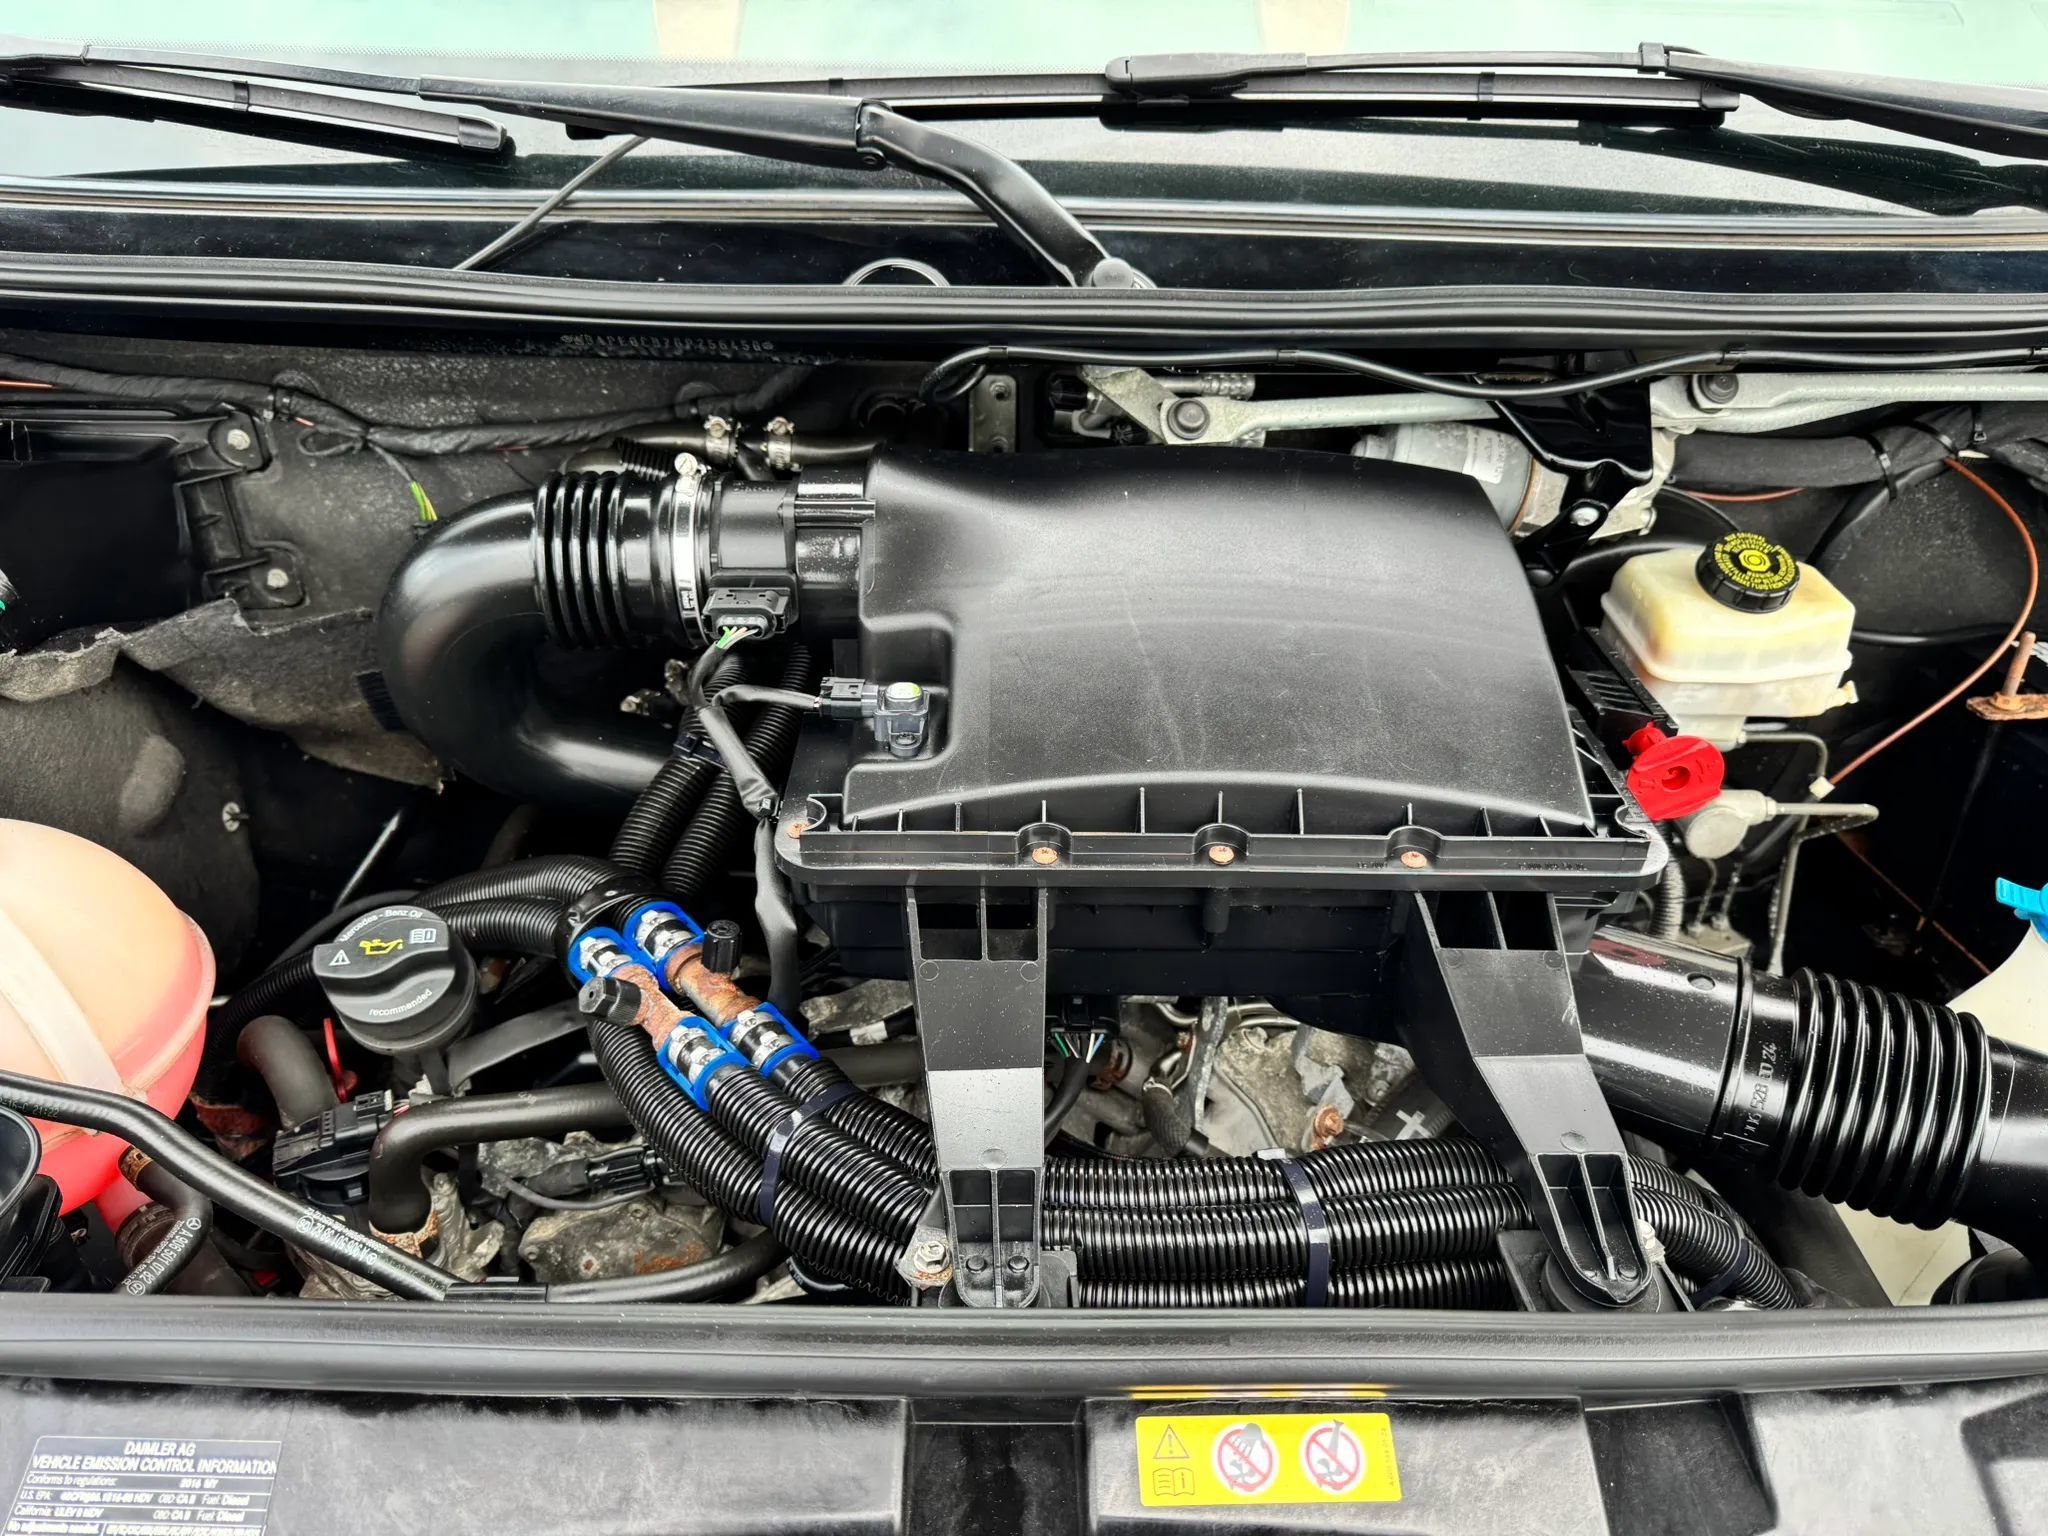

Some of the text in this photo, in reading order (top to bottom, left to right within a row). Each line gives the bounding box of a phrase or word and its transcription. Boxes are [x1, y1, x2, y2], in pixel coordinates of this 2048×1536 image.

[340, 911, 378, 942] Mercedes
[385, 909, 409, 918] Benz
[369, 988, 433, 1016] recommended
[179, 1228, 193, 1238] A
[169, 1235, 189, 1252] 906
[161, 1249, 177, 1266] 501
[150, 1261, 165, 1276] 07
[139, 1271, 156, 1285] 82
[124, 1441, 196, 1457] DAIMLER AG
[32, 1454, 277, 1474] VEHICLE EMISSION CONTROL INFORMATION
[27, 1474, 63, 1485] Conforms
[64, 1475, 73, 1485] to
